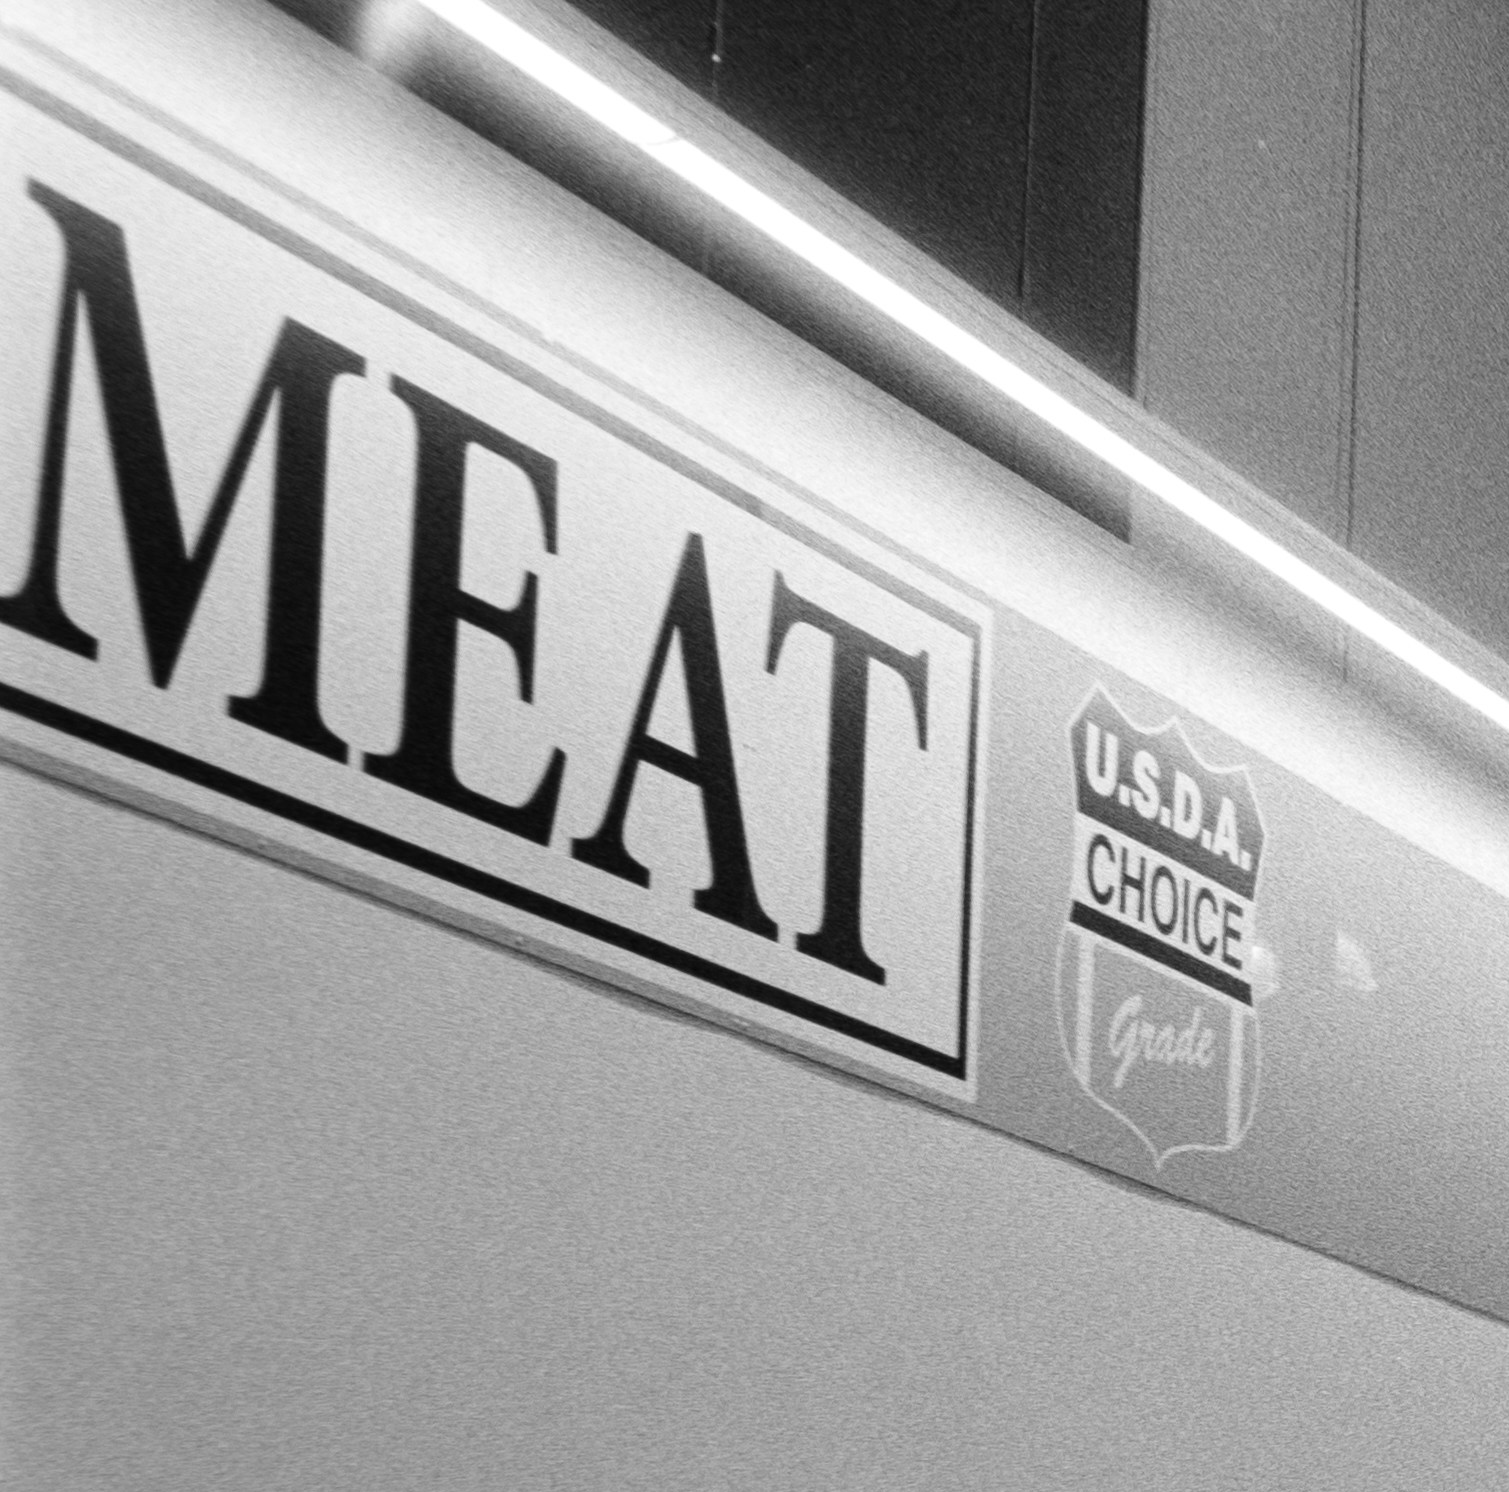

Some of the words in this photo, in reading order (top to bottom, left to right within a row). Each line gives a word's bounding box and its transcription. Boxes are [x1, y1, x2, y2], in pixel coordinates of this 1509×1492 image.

[0, 177, 930, 987] MEAT
[1086, 721, 1252, 871] U.S.D.A.
[1087, 834, 1244, 971] CHOICE
[1107, 995, 1216, 1089] Grade
